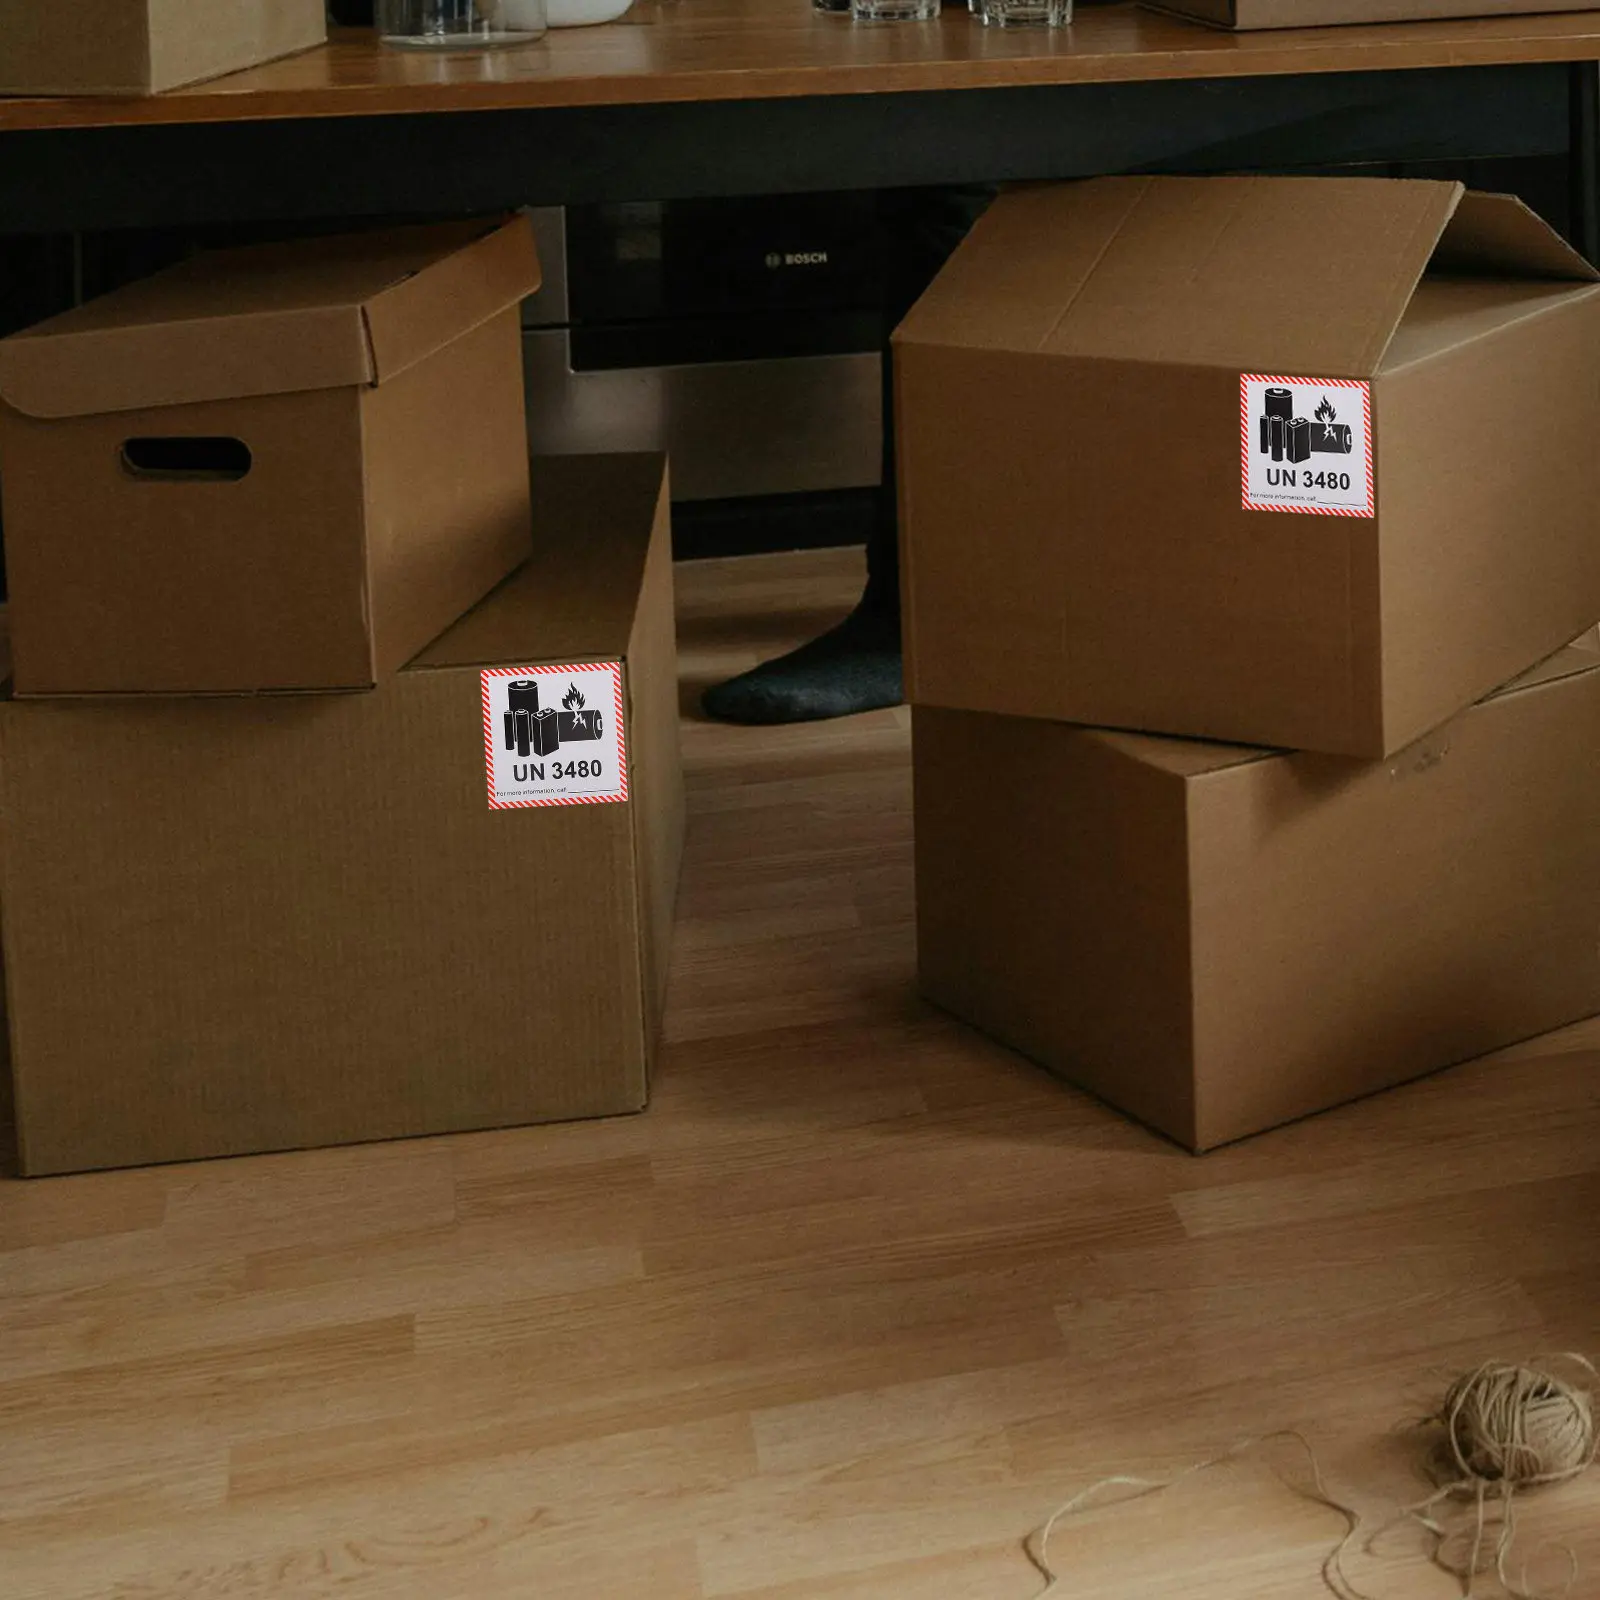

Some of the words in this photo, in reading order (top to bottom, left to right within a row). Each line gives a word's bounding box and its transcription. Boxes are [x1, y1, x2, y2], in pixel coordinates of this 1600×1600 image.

[785, 251, 828, 265] BOSCH
[1266, 468, 1297, 487] UN
[1302, 470, 1351, 490] 3480
[513, 763, 545, 782] UN
[551, 759, 602, 780] 3480
